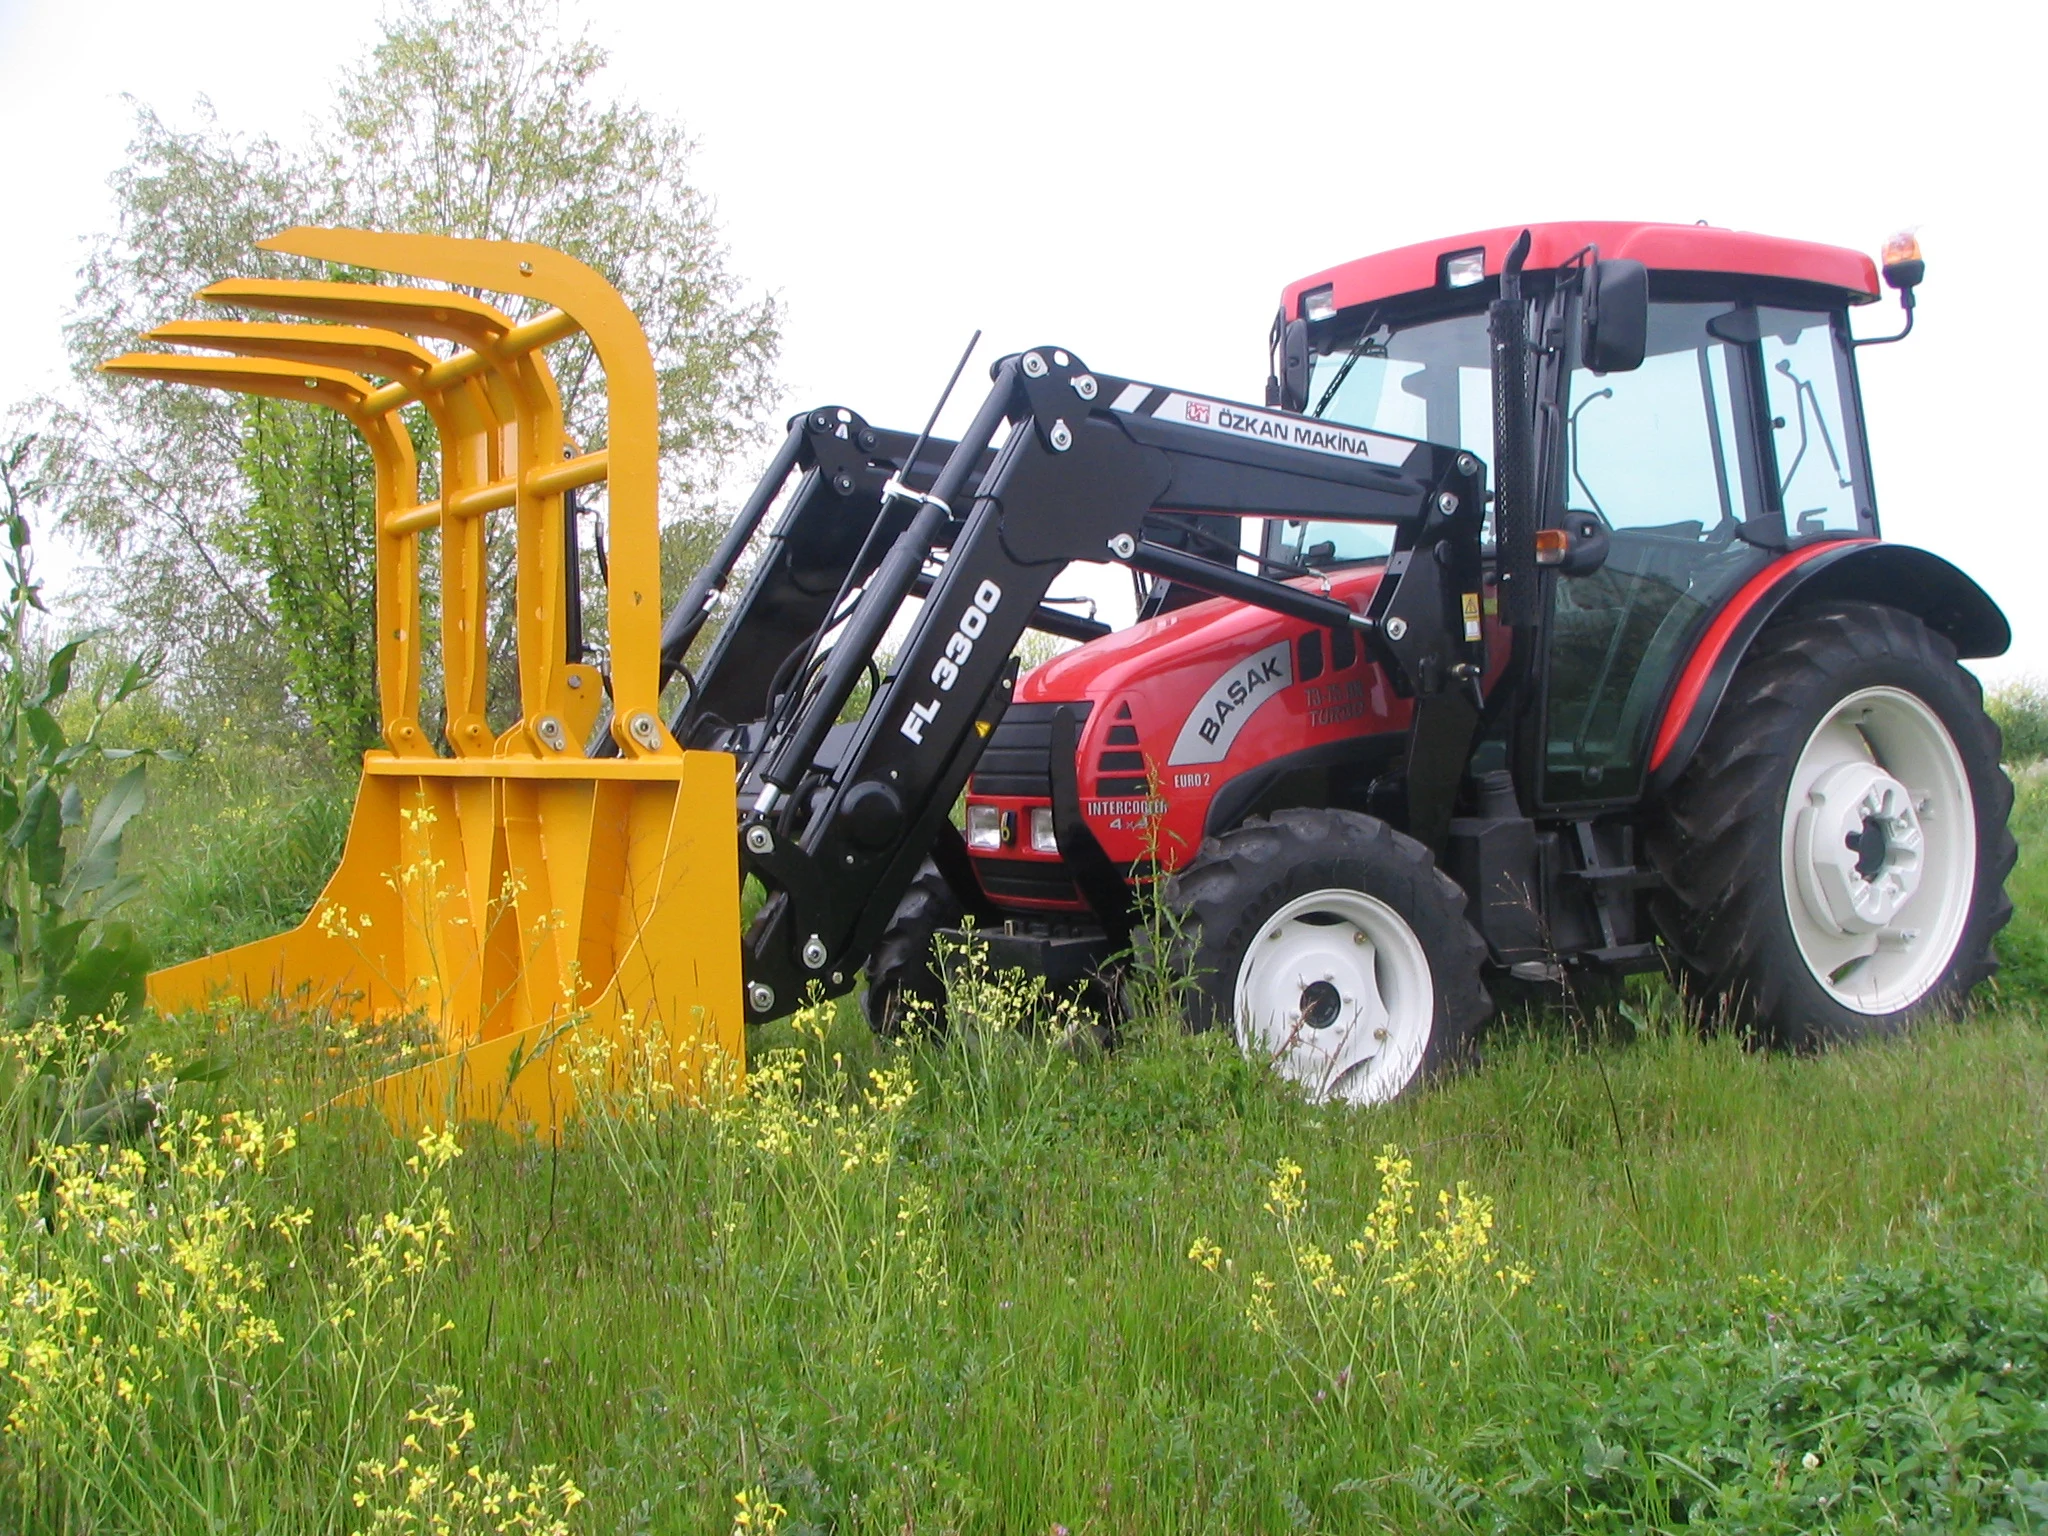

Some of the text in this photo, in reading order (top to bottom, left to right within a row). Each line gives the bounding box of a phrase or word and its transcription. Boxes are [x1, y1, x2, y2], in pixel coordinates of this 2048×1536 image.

[1217, 408, 1288, 441] ÖZKAN
[1294, 427, 1369, 456] MAKİNA
[900, 579, 1002, 745] FL 3300
[1198, 656, 1283, 745] BAŞAK
[1174, 773, 1210, 788] EURO 2
